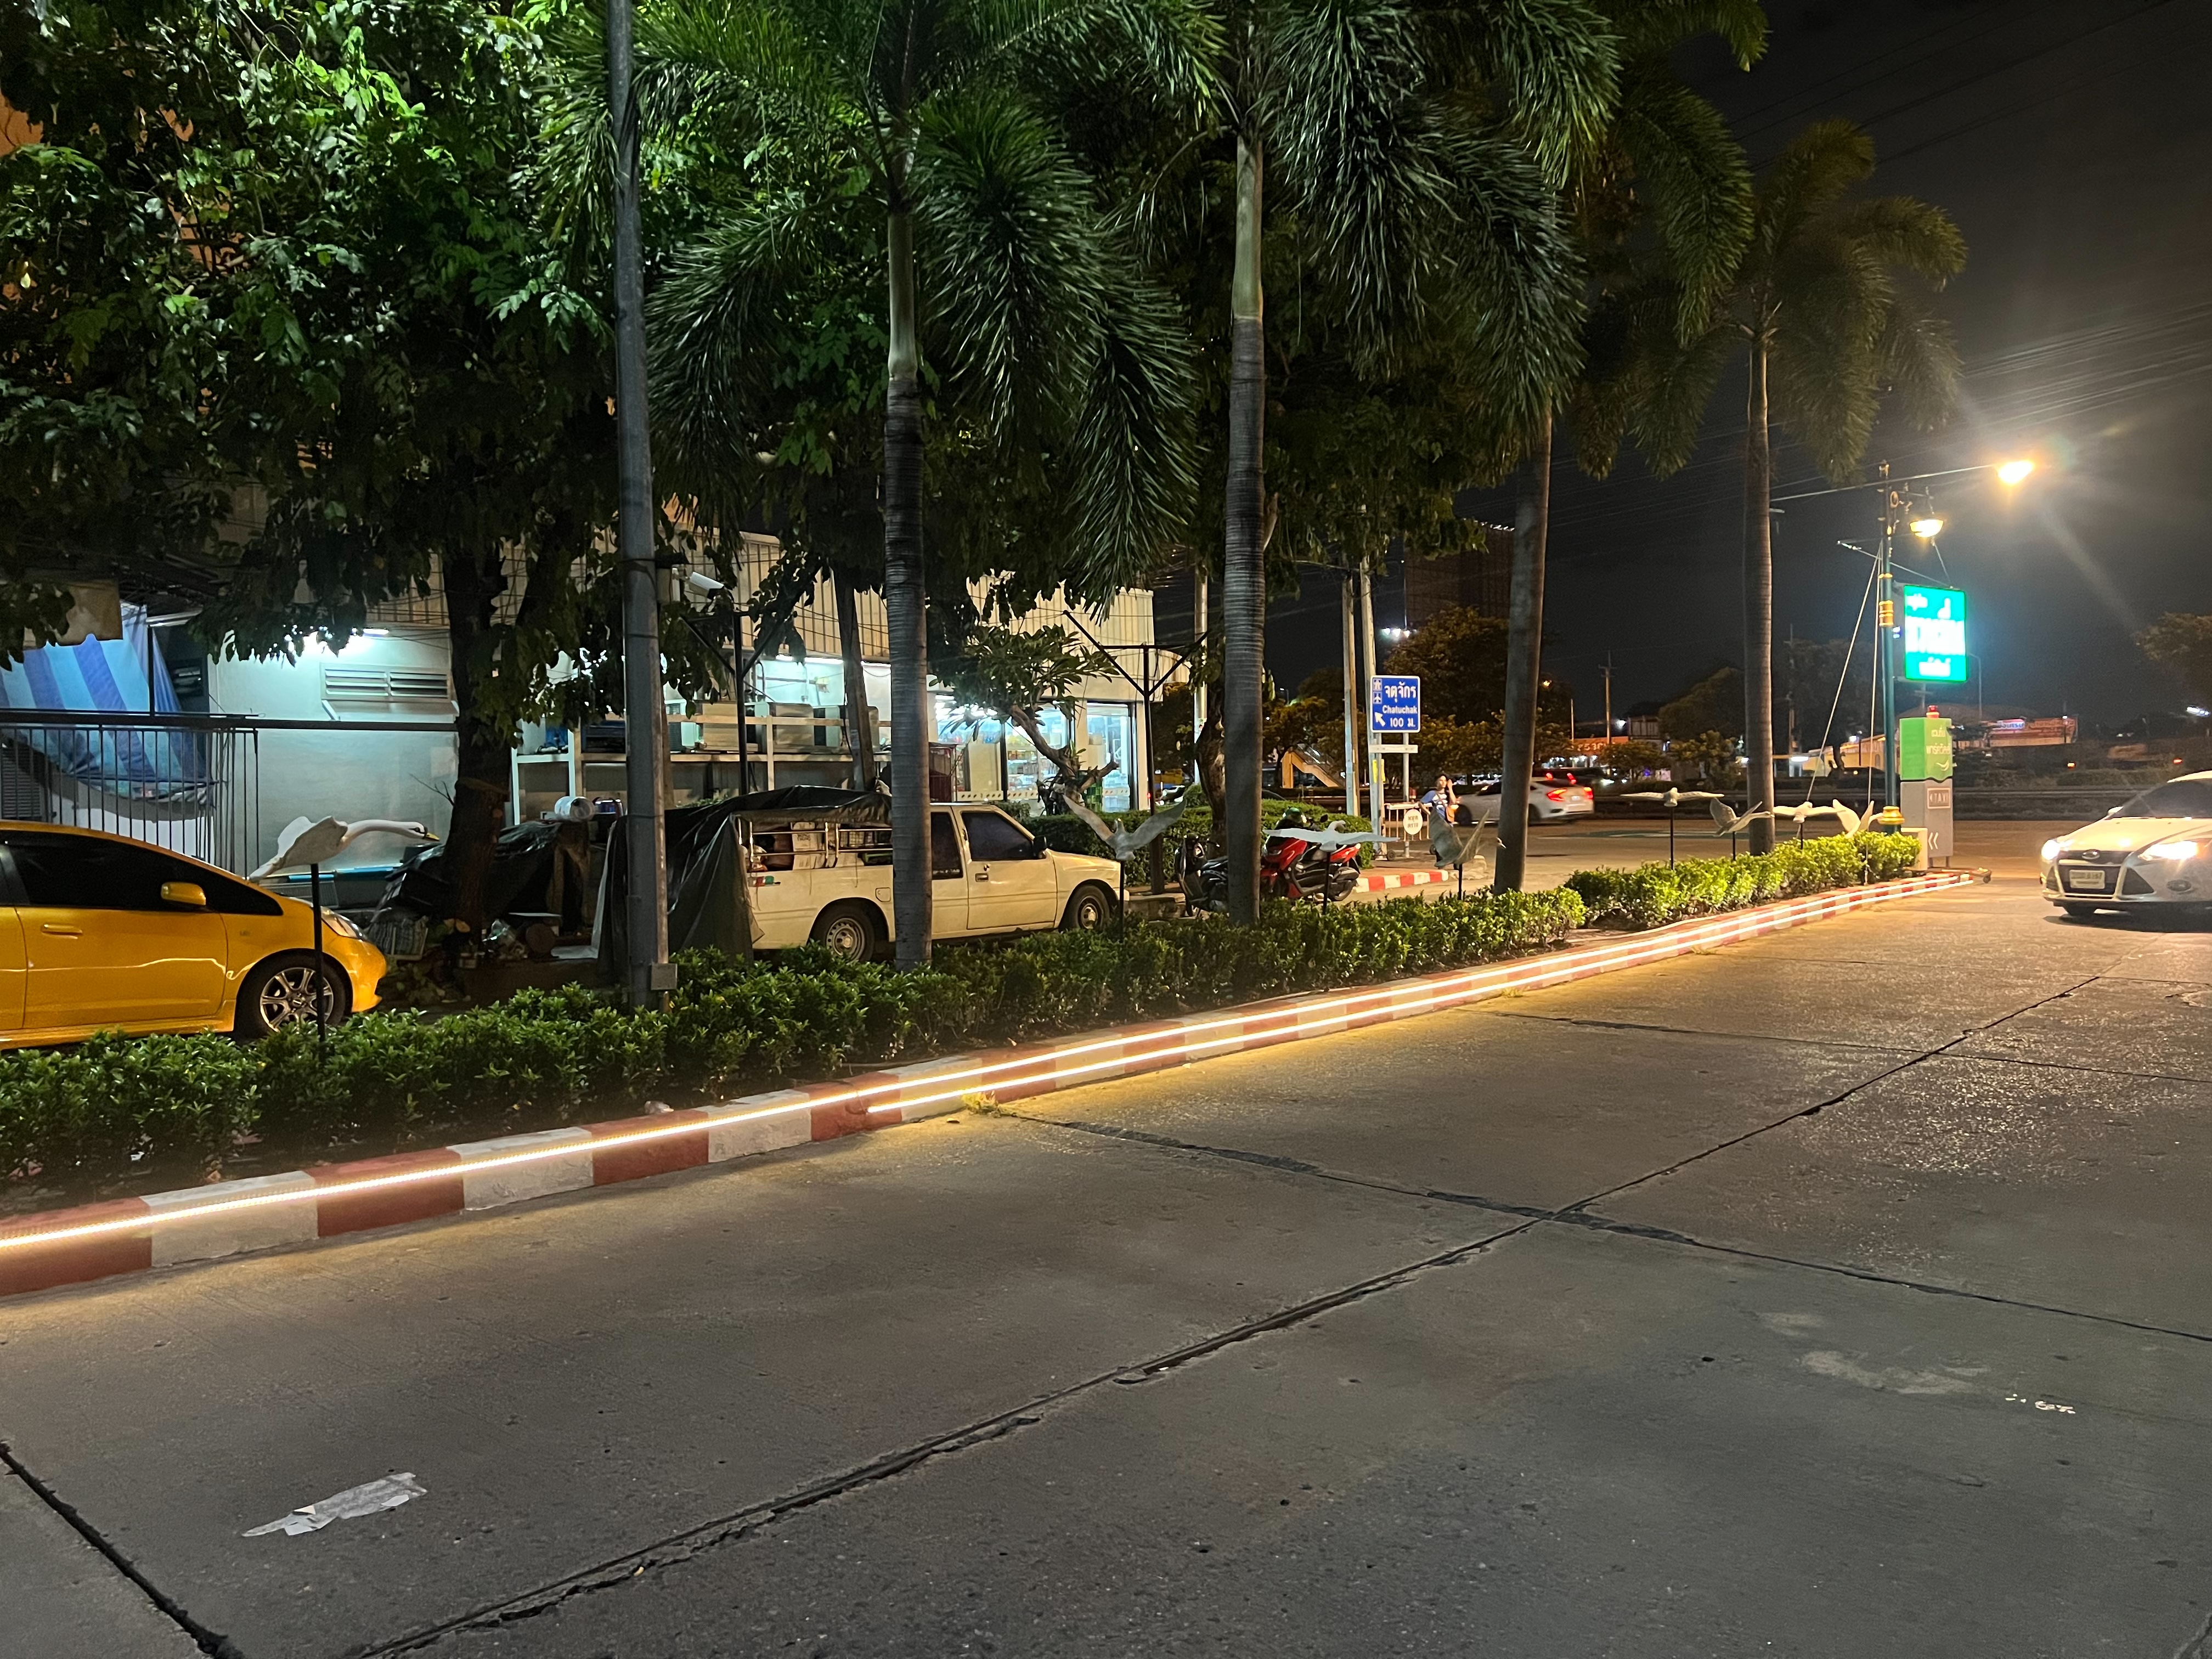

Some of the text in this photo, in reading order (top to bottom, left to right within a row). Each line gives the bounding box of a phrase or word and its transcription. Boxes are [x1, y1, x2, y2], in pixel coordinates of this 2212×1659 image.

[1384, 681, 1417, 703] จตุจักร
[1383, 705, 1418, 714] Chatuchak
[1390, 717, 1404, 727] 100
